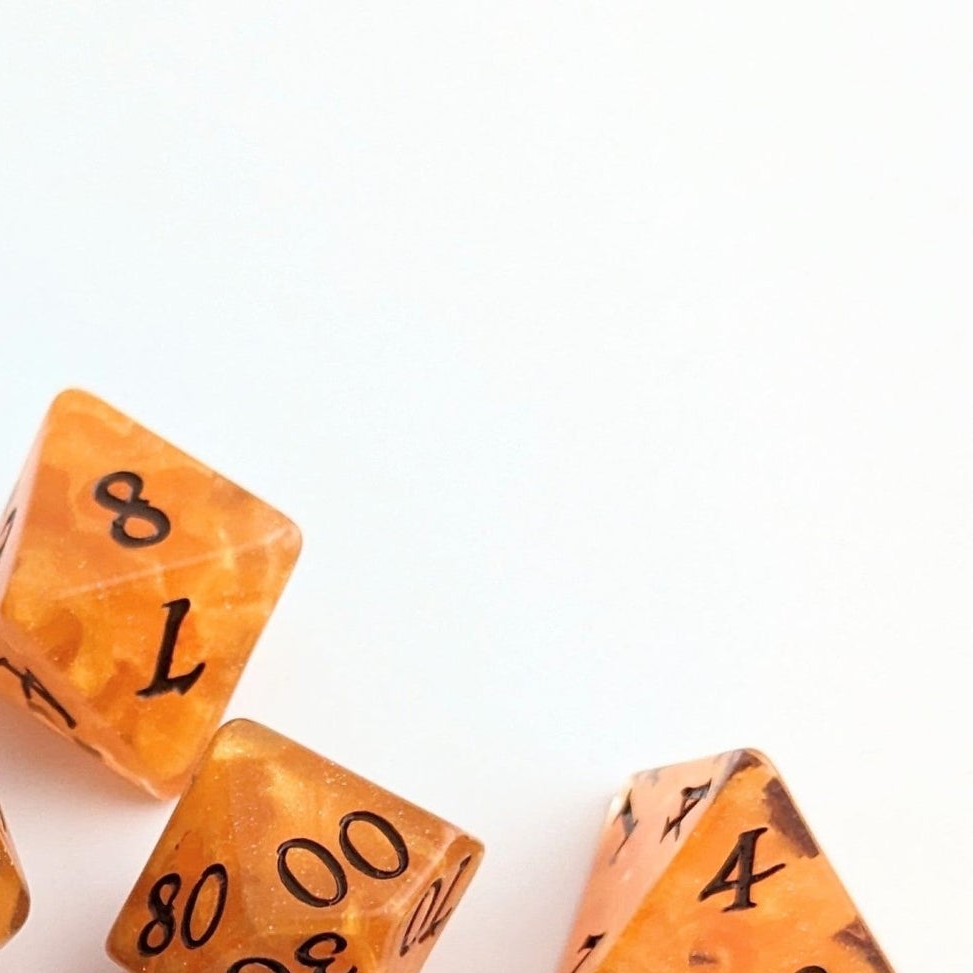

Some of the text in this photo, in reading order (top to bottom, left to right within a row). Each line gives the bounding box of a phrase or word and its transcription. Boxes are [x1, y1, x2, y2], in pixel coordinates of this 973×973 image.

[95, 471, 171, 546] 8
[135, 597, 207, 698] 7
[277, 811, 409, 908] 00
[698, 826, 787, 913] 4
[137, 863, 228, 958] 80
